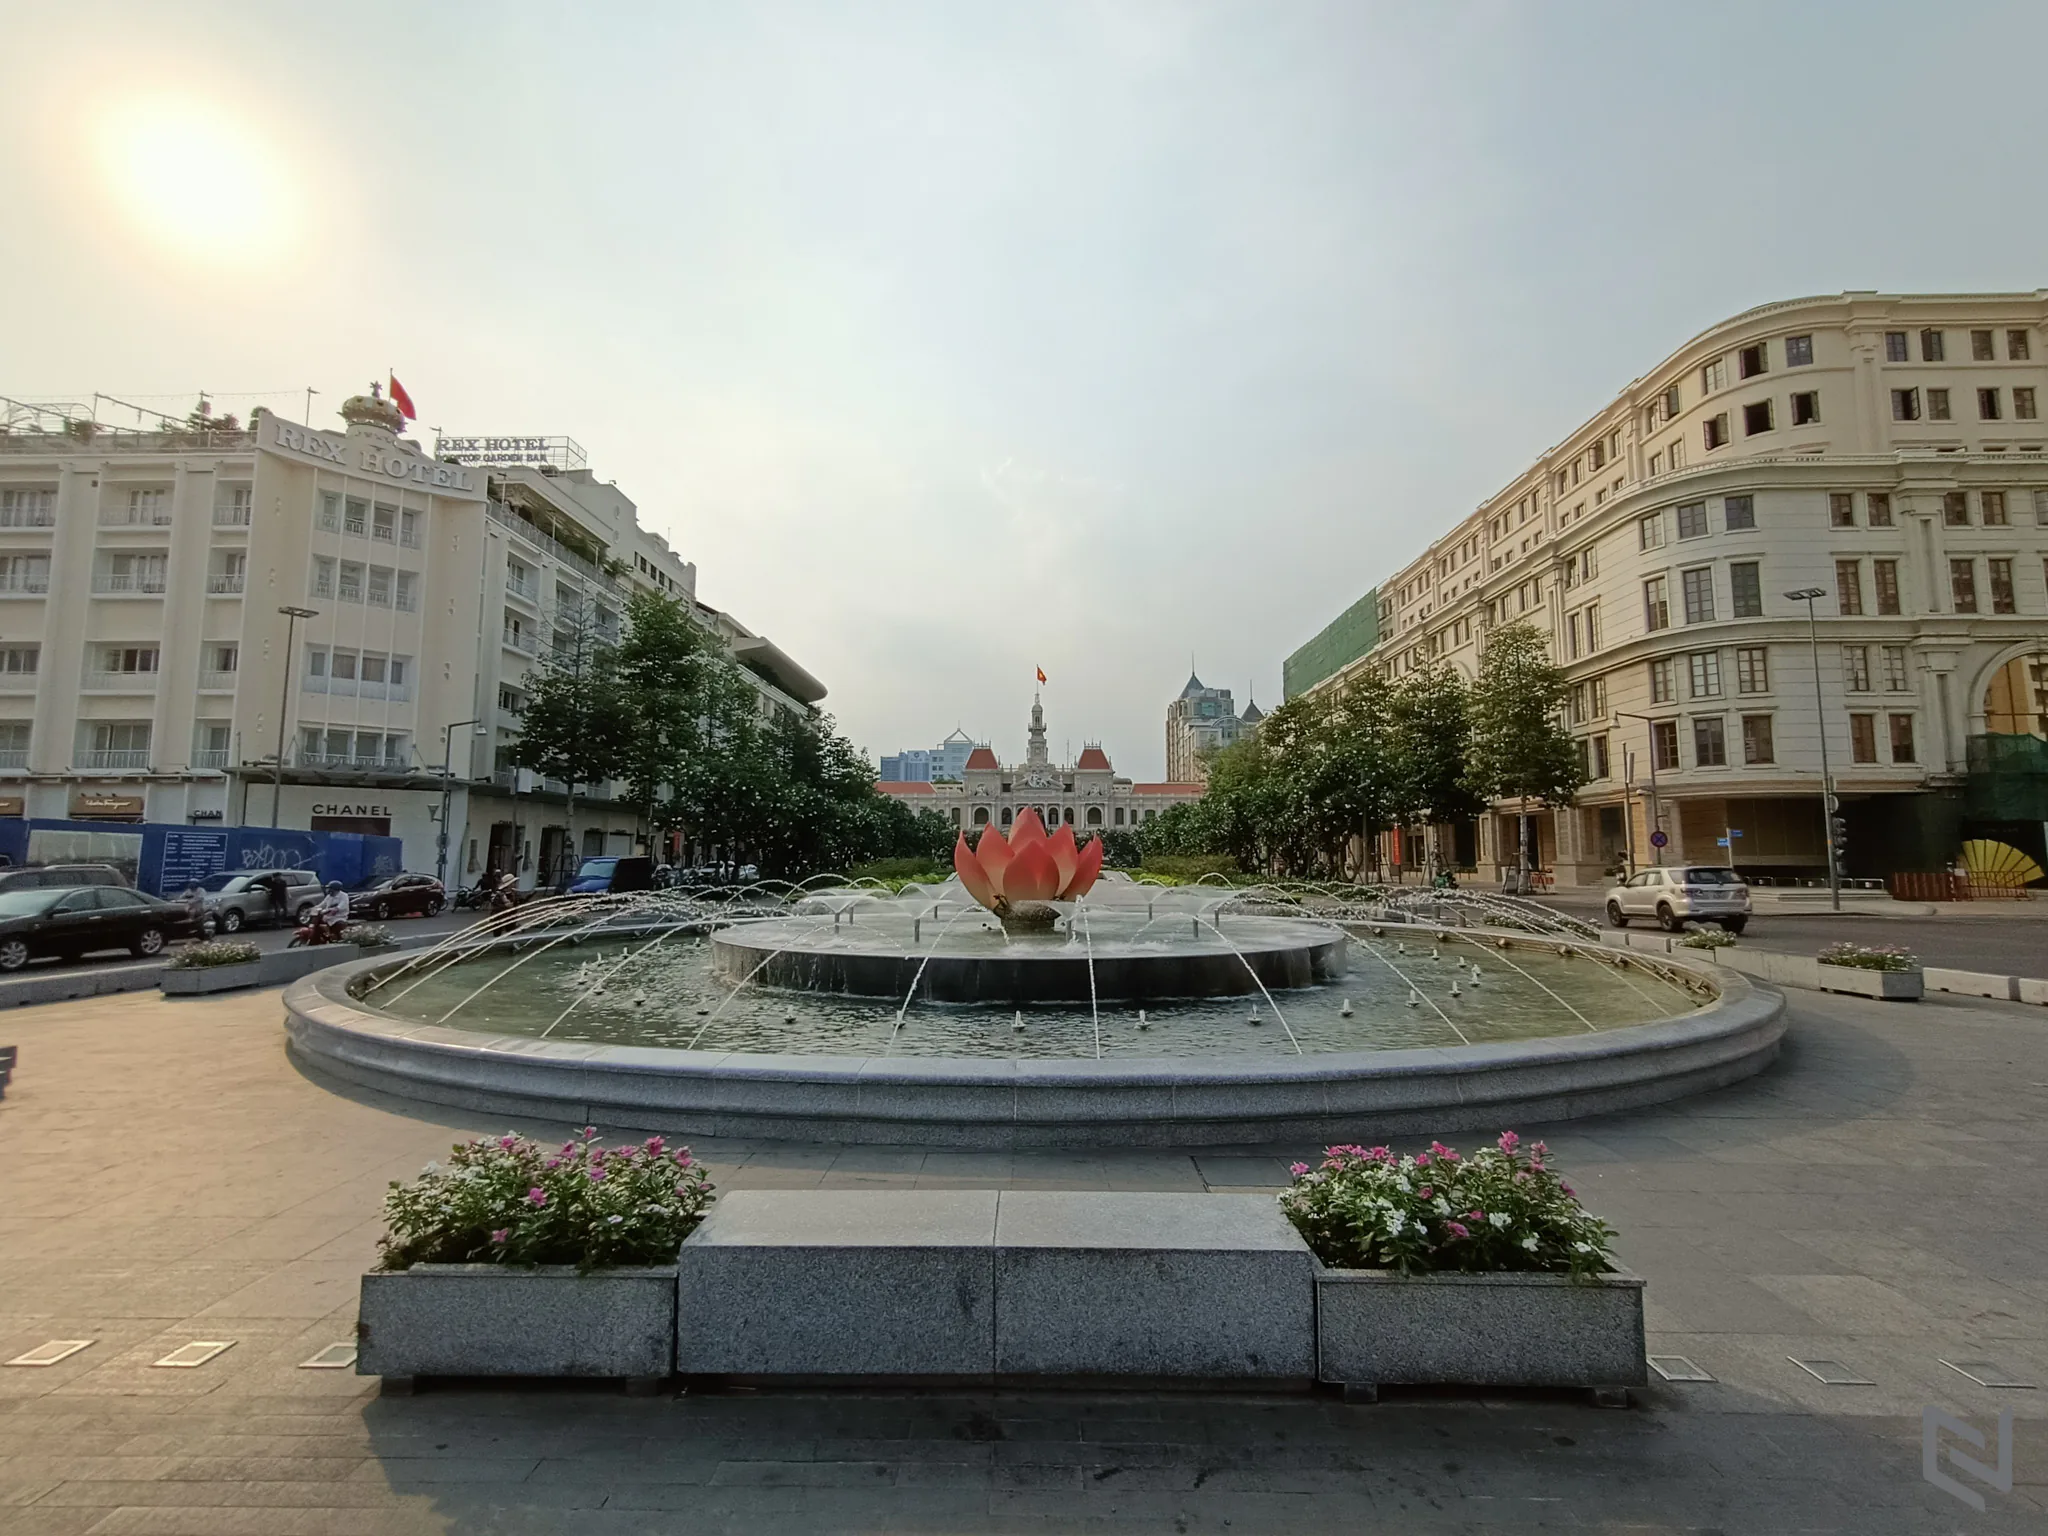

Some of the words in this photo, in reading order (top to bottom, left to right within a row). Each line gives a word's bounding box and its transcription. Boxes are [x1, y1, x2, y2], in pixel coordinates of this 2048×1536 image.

[436, 438, 480, 451] REX
[484, 438, 550, 451] HOTEL
[275, 424, 347, 465] REX
[360, 450, 474, 491] HOTEL
[483, 454, 523, 462] GARDEN
[312, 804, 393, 816] CHANEL
